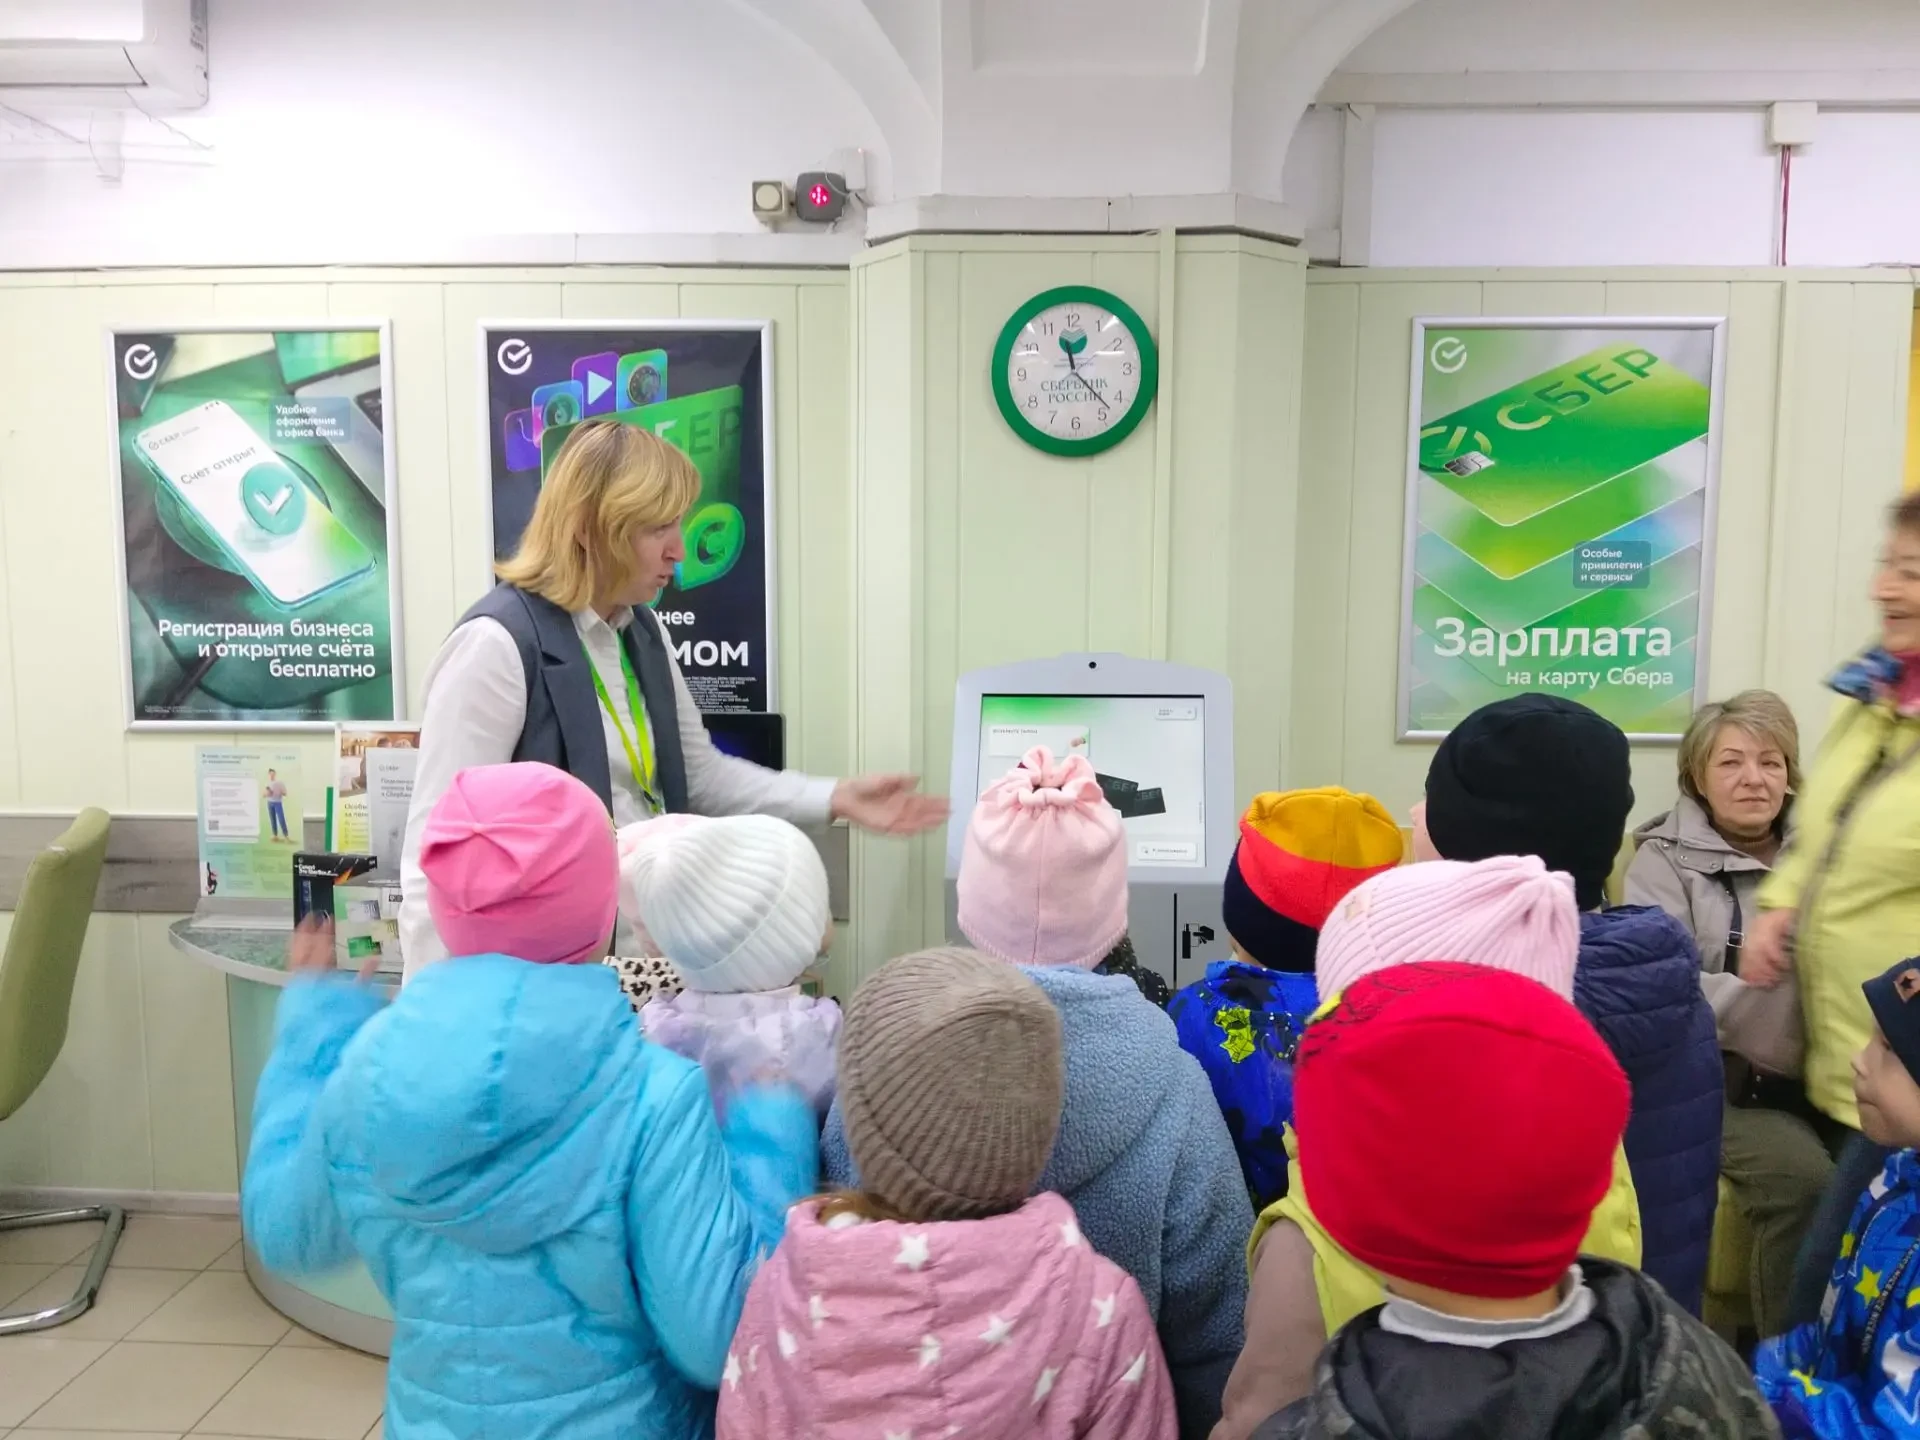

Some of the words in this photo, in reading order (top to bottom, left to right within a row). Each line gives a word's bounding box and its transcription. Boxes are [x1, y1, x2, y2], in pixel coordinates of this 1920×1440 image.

[1066, 313, 1080, 328] 12
[1095, 319, 1102, 332] 1
[1043, 322, 1054, 336] 11
[1024, 342, 1039, 357] 10
[1113, 337, 1122, 352] 2
[1017, 368, 1027, 381] 9
[1122, 362, 1132, 376] 3
[1040, 378, 1108, 392] СБЕРБАНК
[1496, 347, 1660, 431] СБЕР
[1028, 395, 1038, 409] 8
[1048, 391, 1103, 403] РОССИИ
[1113, 389, 1122, 404] 4
[275, 404, 317, 415] Удобное
[1097, 407, 1107, 421] 5
[276, 416, 337, 427] оформление
[1048, 410, 1058, 424] 7
[1071, 416, 1081, 430] 6
[284, 428, 314, 439] офисе
[316, 426, 345, 437] банка
[181, 466, 211, 486] Счет
[212, 446, 257, 471] открыт
[1581, 548, 1623, 558] Особые
[1581, 562, 1643, 571] привилегии
[1590, 574, 1633, 584] сервисы
[657, 611, 695, 626] нее
[158, 619, 284, 641] Регистрация
[290, 618, 374, 637] бизнеса
[1434, 617, 1671, 666] Зарплата
[198, 644, 210, 657] и
[216, 643, 312, 660] открытие
[318, 639, 375, 657] счёта
[269, 658, 376, 678] бесплатно
[1506, 671, 1531, 686] на
[1538, 671, 1600, 689] карту
[1606, 667, 1674, 689] Сбера
